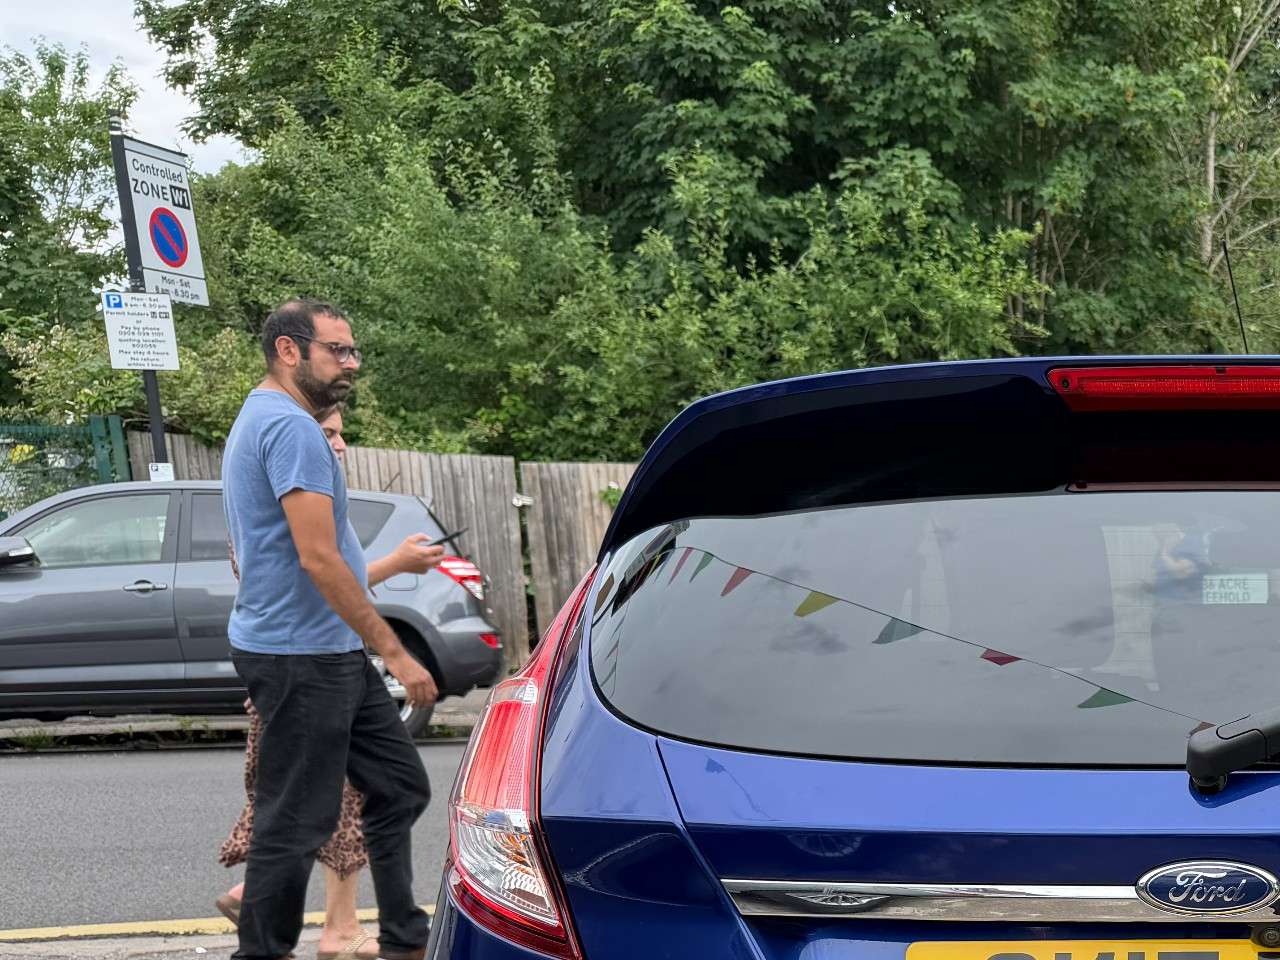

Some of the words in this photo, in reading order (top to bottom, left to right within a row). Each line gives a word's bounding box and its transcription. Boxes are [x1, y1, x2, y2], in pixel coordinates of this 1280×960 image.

[132, 158, 183, 183] Controlled
[131, 177, 169, 201] ZONE
[170, 187, 190, 209] W1
[161, 276, 175, 286] Mon
[1168, 871, 1247, 902] Ford
